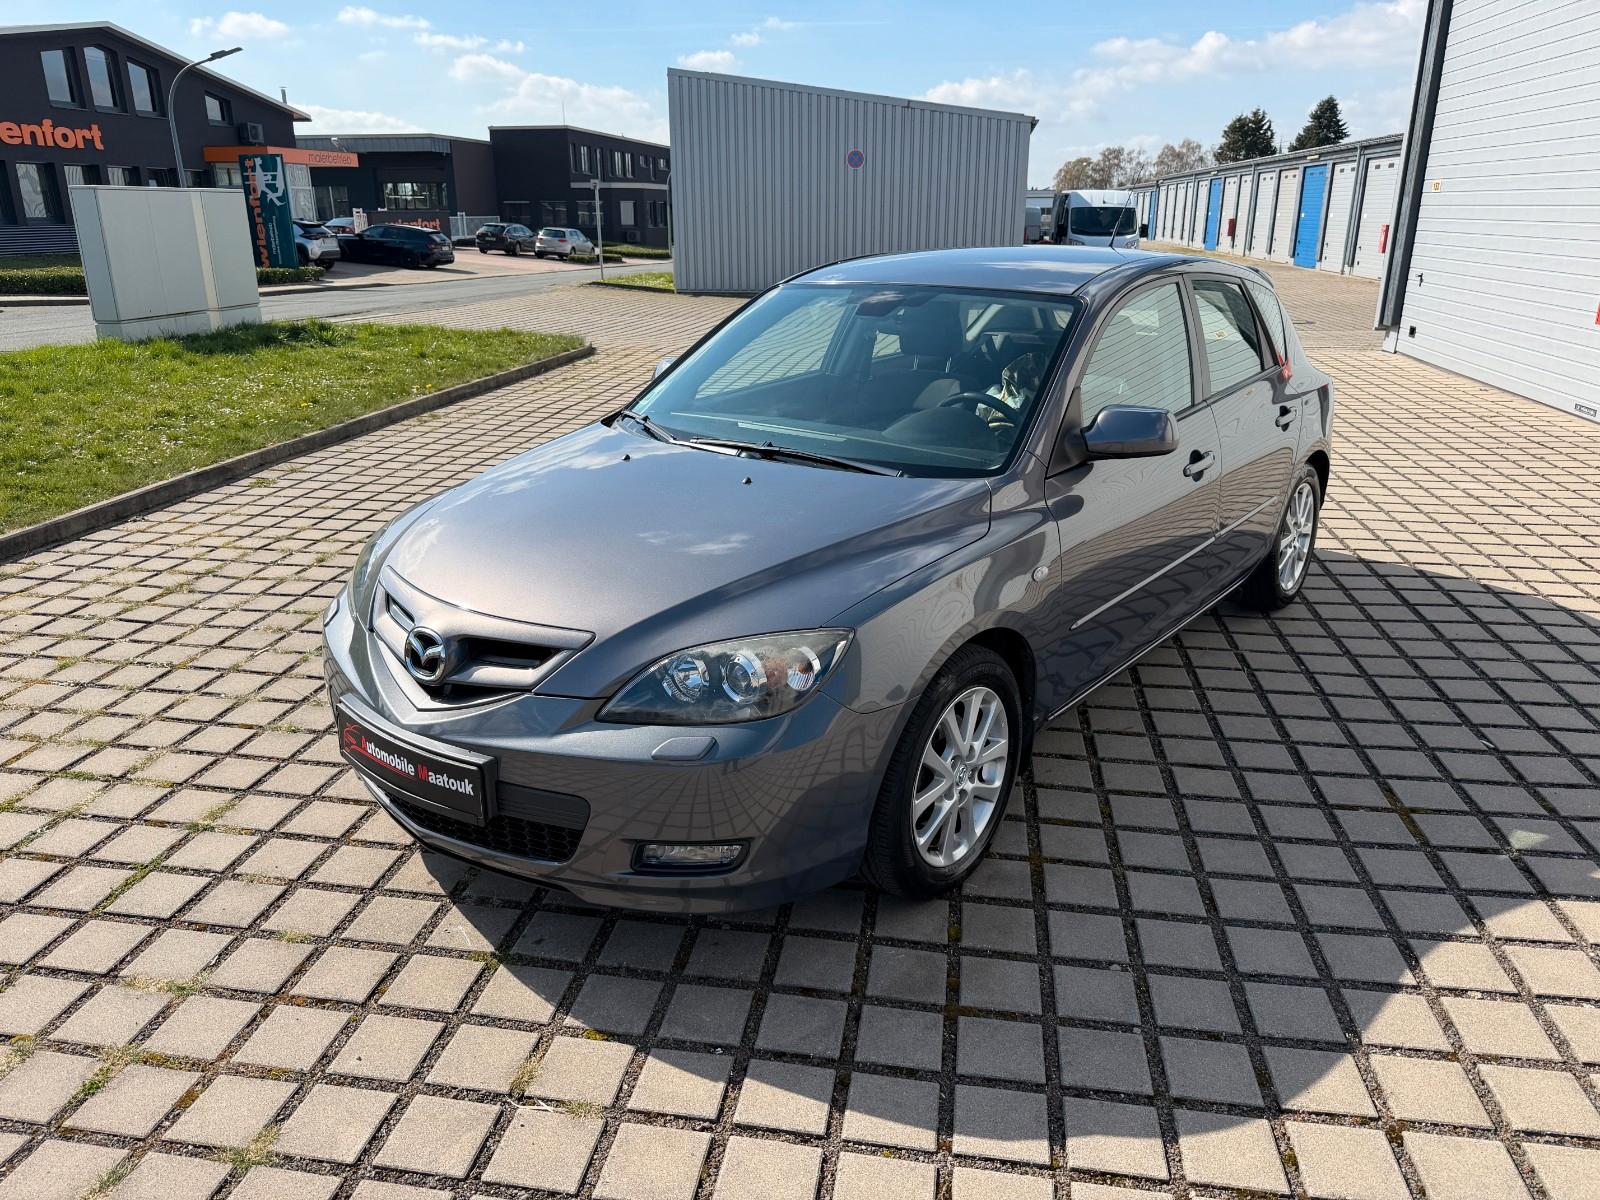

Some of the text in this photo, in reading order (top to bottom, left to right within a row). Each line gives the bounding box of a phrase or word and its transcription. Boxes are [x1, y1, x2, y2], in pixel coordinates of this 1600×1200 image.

[0, 118, 105, 150] enfort
[308, 151, 352, 165] malerbetrieb
[361, 736, 474, 796] Automobile Maatouk
